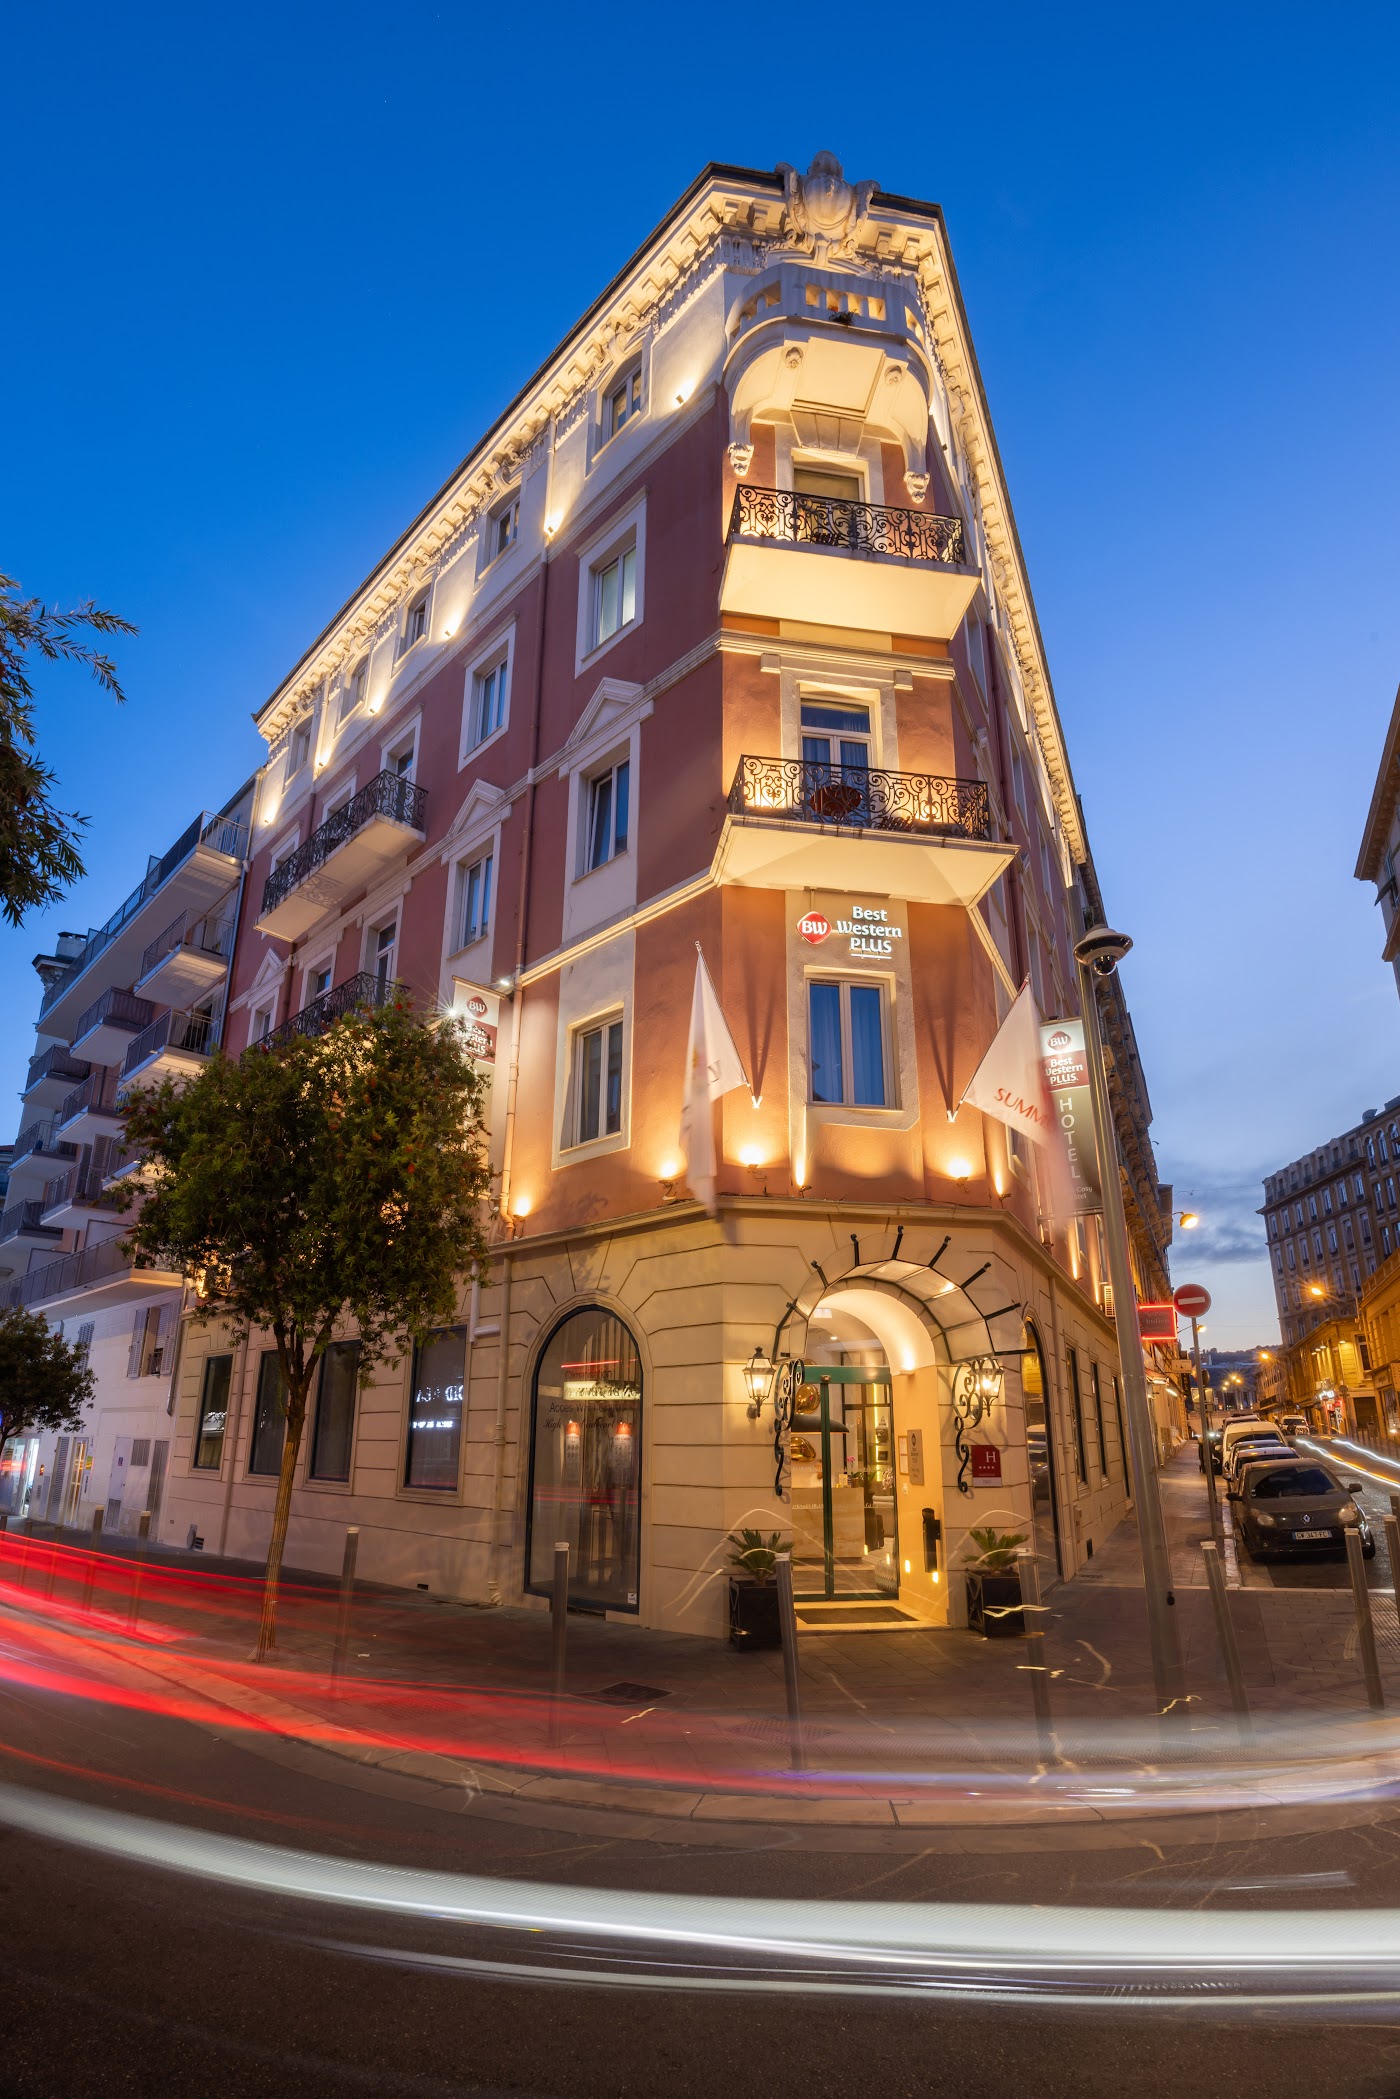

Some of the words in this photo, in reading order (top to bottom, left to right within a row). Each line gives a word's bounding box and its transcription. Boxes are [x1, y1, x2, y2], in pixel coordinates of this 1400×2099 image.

[852, 906, 888, 921] Best
[801, 920, 828, 935] BW
[837, 920, 903, 938] Western
[850, 937, 892, 953] PLUS
[468, 1000, 486, 1013] BW
[1050, 1035, 1069, 1047] BW
[1050, 1056, 1073, 1067] Best
[1060, 1097, 1081, 1179] HOTEL
[1076, 1186, 1093, 1194] Cosy
[985, 1451, 996, 1463] H
